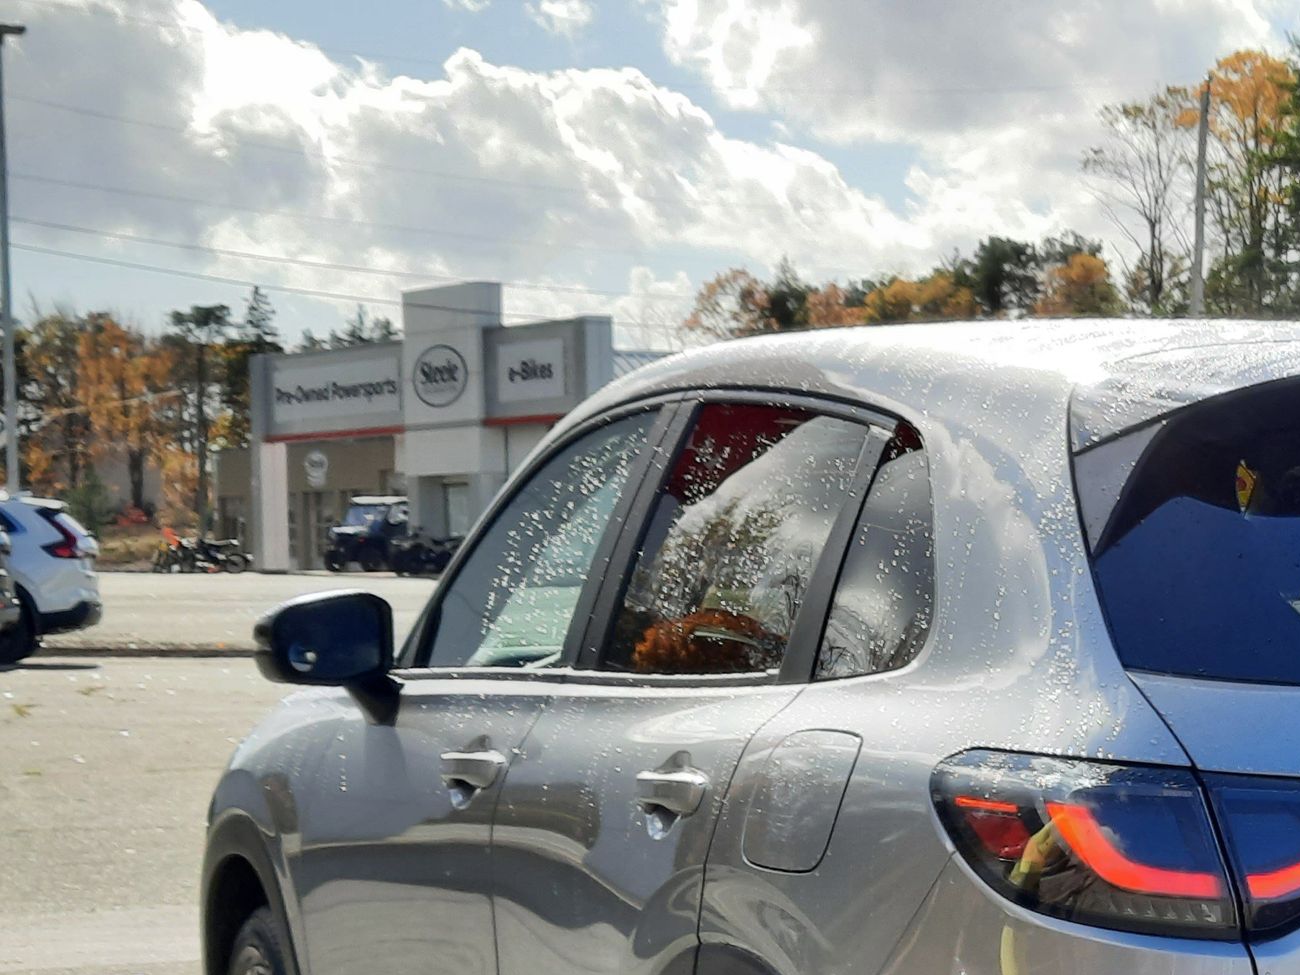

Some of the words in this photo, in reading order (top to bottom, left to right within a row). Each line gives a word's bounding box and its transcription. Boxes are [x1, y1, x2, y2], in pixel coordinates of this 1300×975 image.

[420, 358, 459, 385] Steele
[275, 382, 329, 404] Pre-Owned
[331, 377, 398, 403] Powersports
